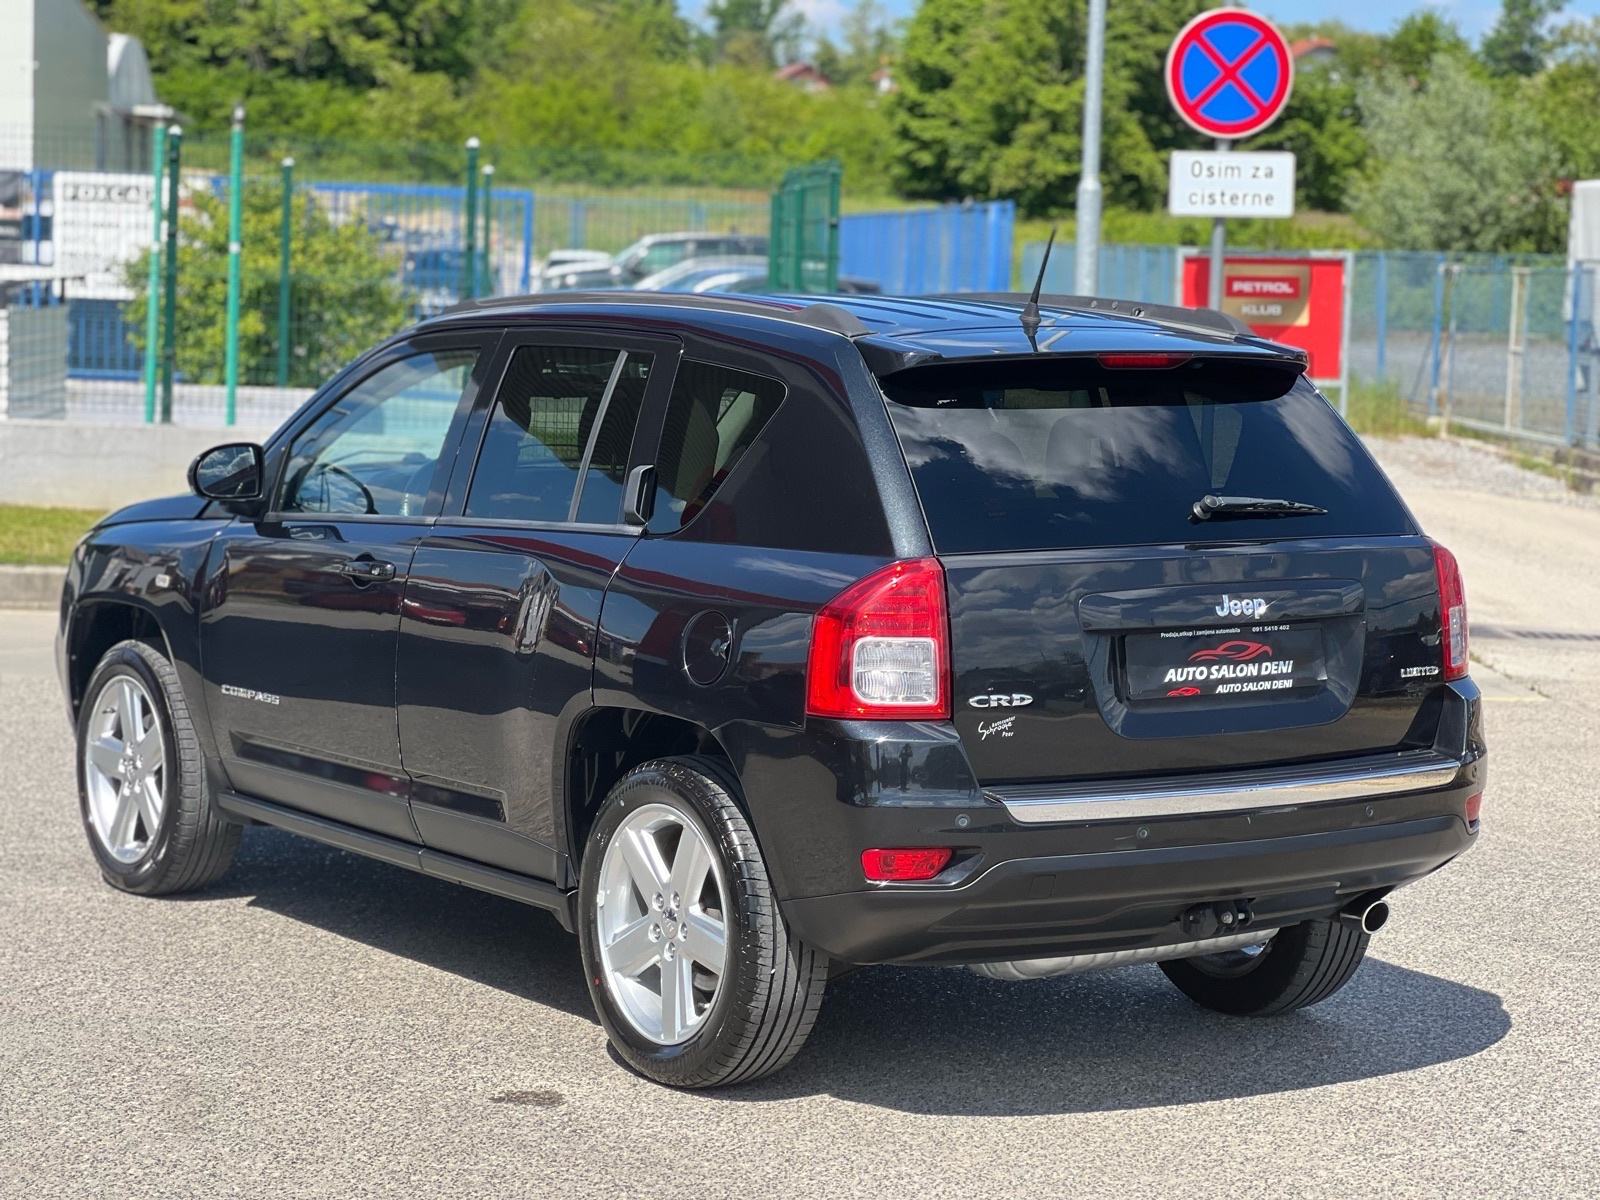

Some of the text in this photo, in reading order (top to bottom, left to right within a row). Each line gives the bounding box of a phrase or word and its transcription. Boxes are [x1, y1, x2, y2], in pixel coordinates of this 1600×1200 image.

[1191, 160, 1274, 179] Osim za
[1188, 190, 1275, 206] cisterne
[1232, 280, 1295, 294] PETROL
[1241, 304, 1282, 316] KLUB
[1215, 594, 1267, 619] Jeep
[1163, 660, 1294, 682] AUTO SALON DENI
[1400, 665, 1439, 678] LIMITED
[1215, 679, 1294, 694] AUTO SALON DENI
[221, 684, 281, 705] COMPASS
[968, 693, 1034, 708] CRD
